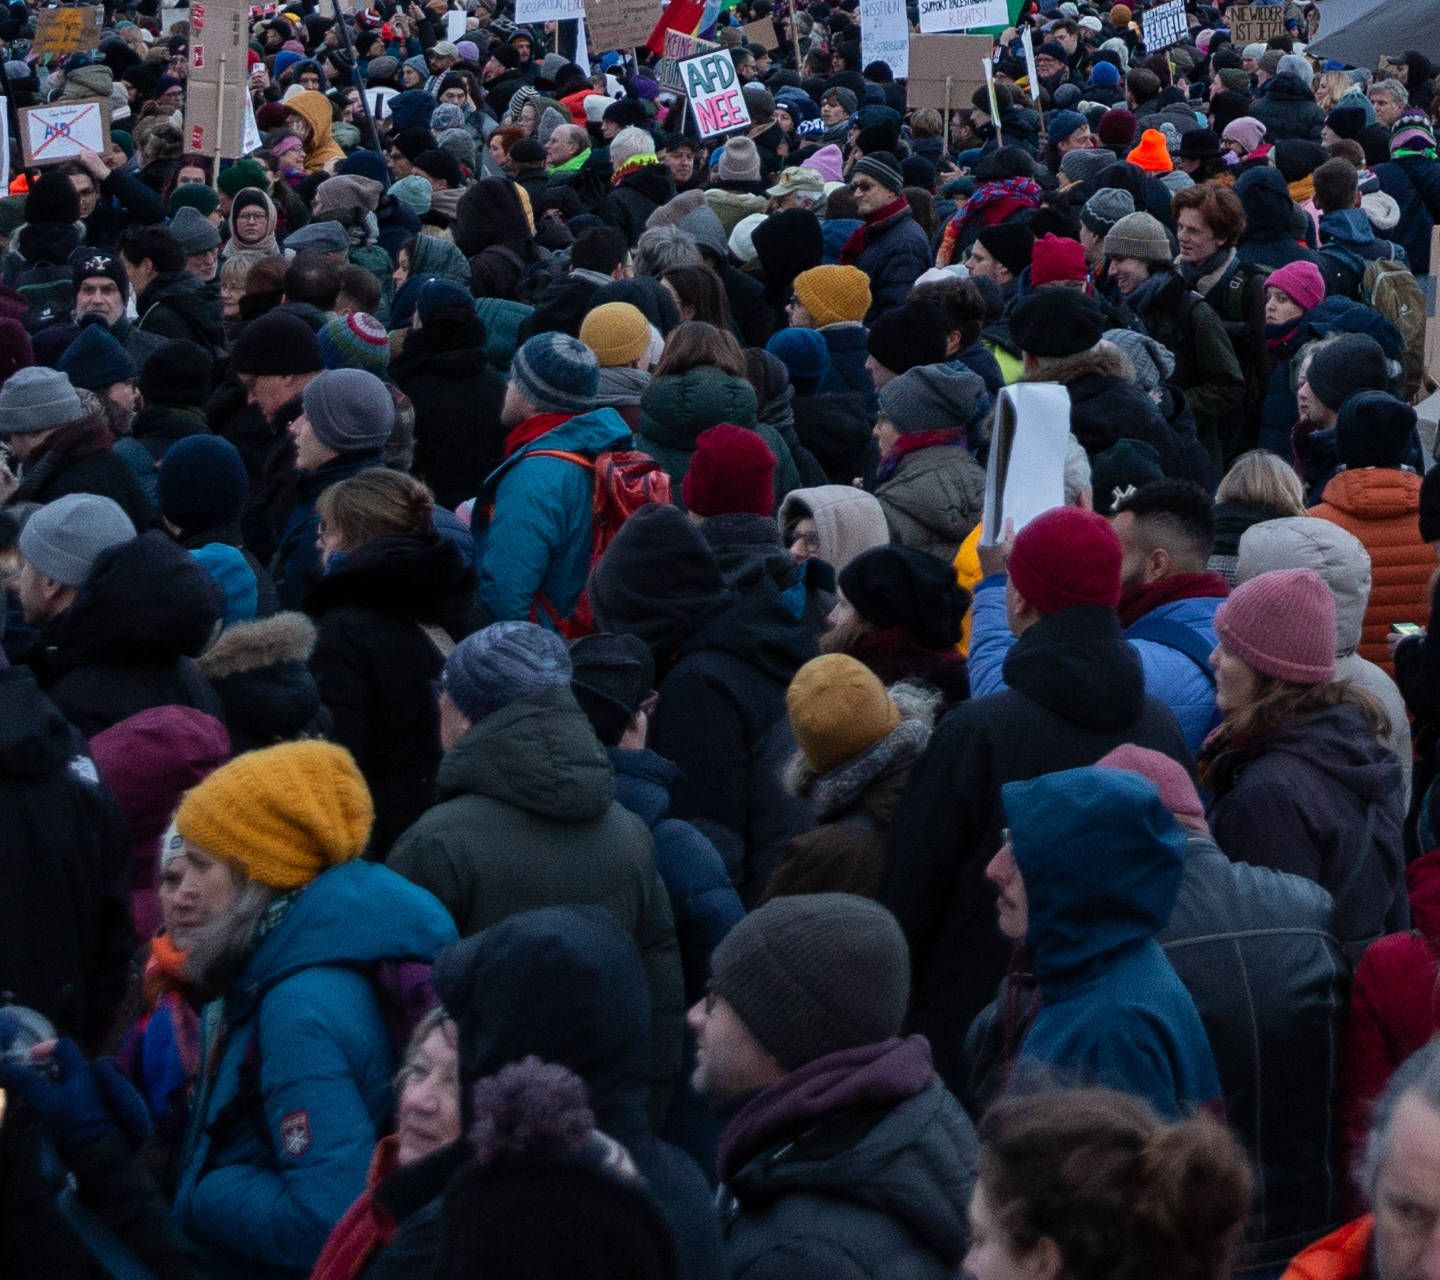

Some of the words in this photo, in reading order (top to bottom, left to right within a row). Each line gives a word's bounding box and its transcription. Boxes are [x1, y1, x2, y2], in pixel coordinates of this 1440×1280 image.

[921, 0, 947, 14] SUPPORT
[1231, 7, 1249, 22] NIE
[1250, 6, 1283, 21] WIEDER
[1236, 23, 1252, 41] IST
[688, 55, 735, 98] AFD
[696, 90, 744, 133] NEE
